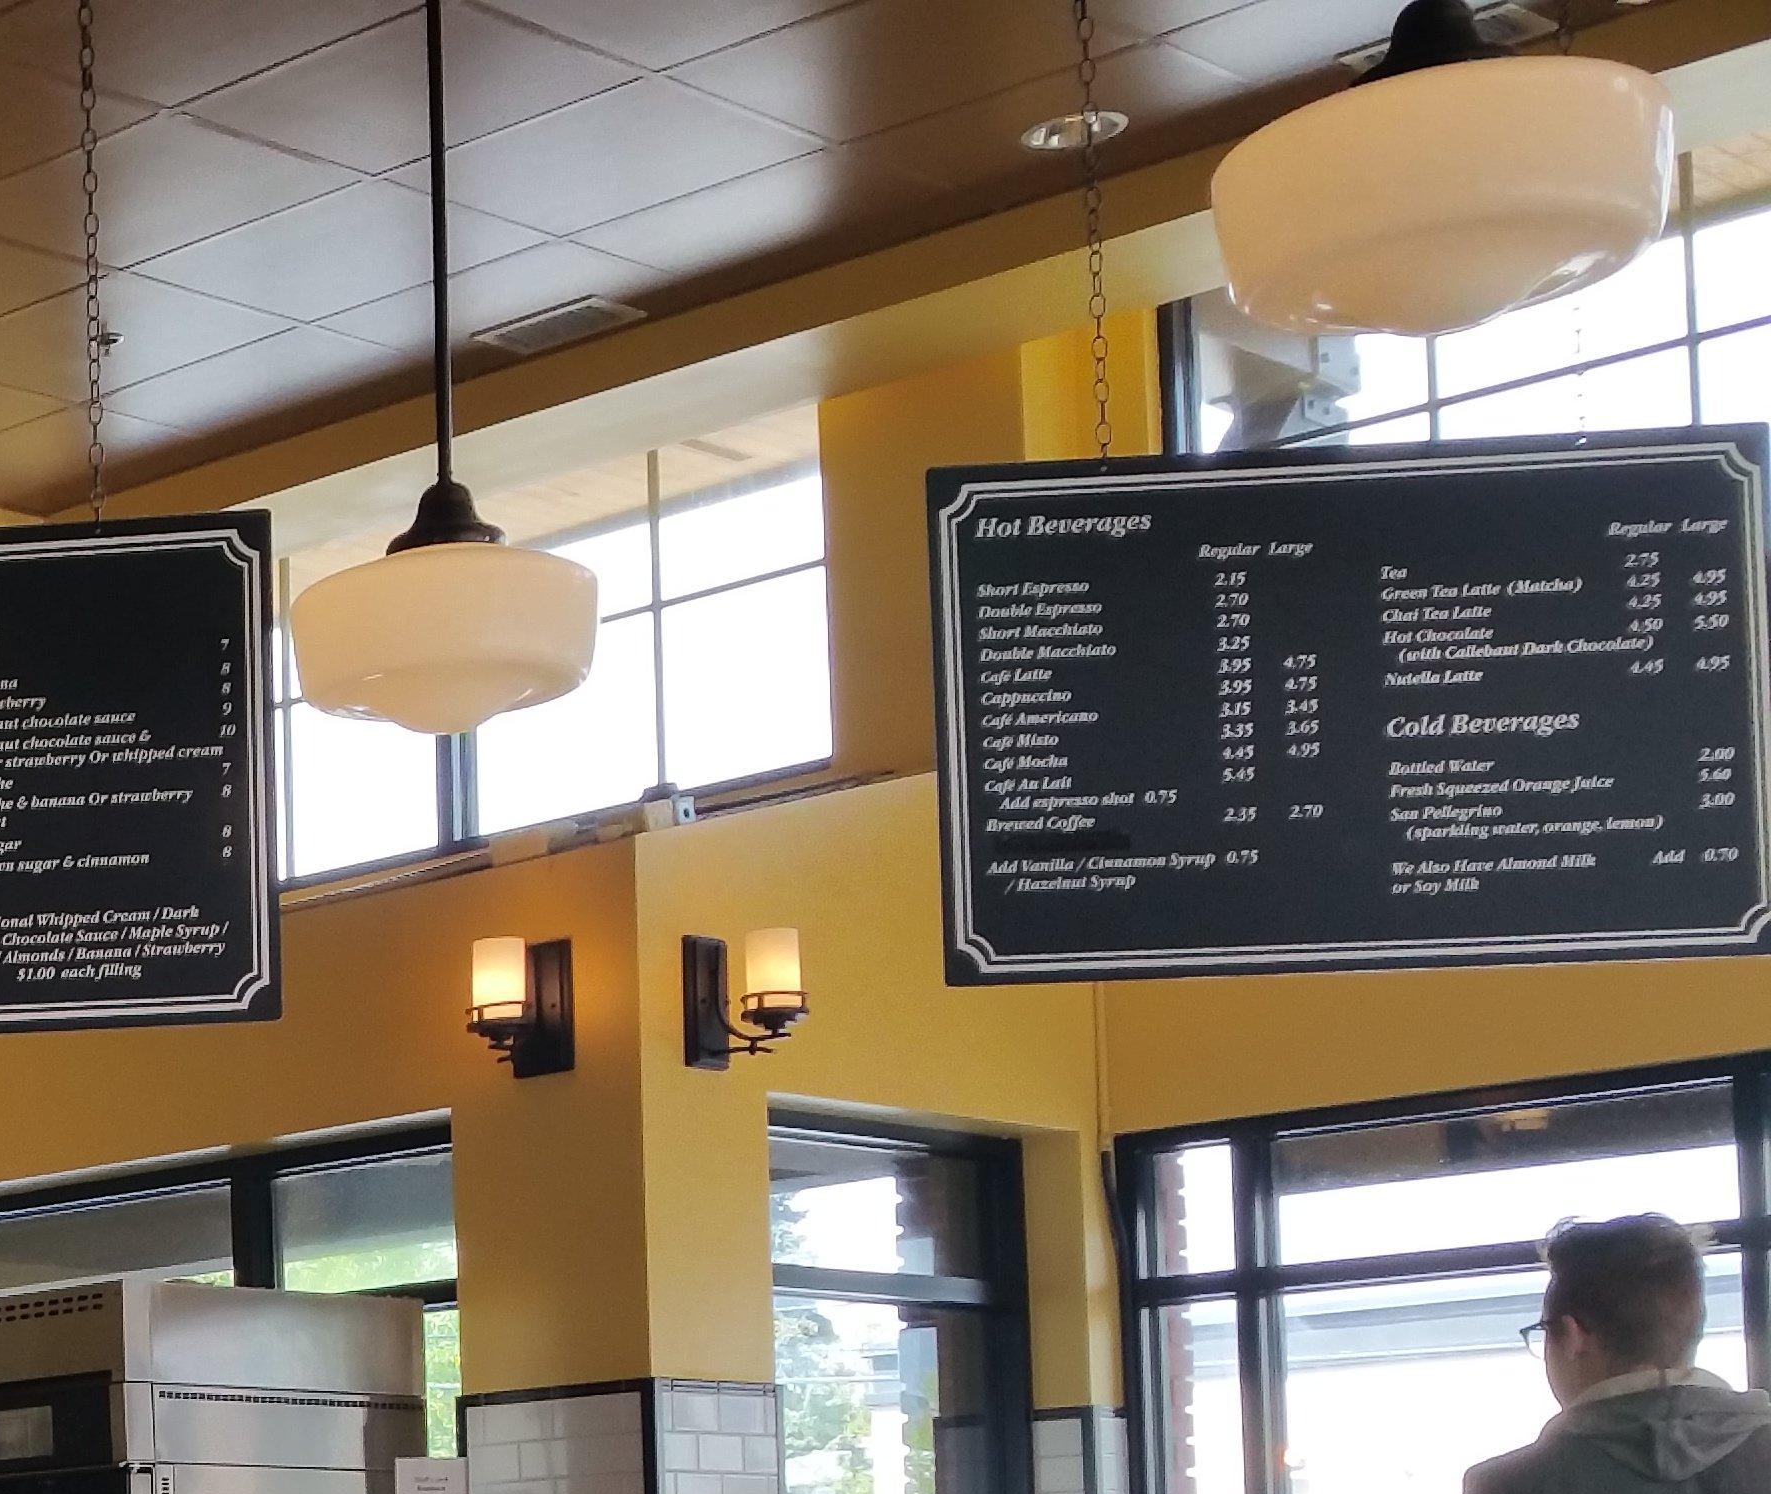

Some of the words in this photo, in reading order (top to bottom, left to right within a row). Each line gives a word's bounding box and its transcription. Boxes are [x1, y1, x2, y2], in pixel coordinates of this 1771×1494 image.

[974, 517, 1022, 538] Hot
[1026, 514, 1152, 538] Beverages
[1198, 542, 1262, 561] Regular
[1267, 541, 1314, 558] Large
[220, 638, 230, 650] 7
[1386, 713, 1446, 738] Cold
[1448, 713, 1580, 738] Beverages
[16, 966, 56, 982] $1.00
[60, 963, 95, 978] each
[96, 962, 142, 981] filling
